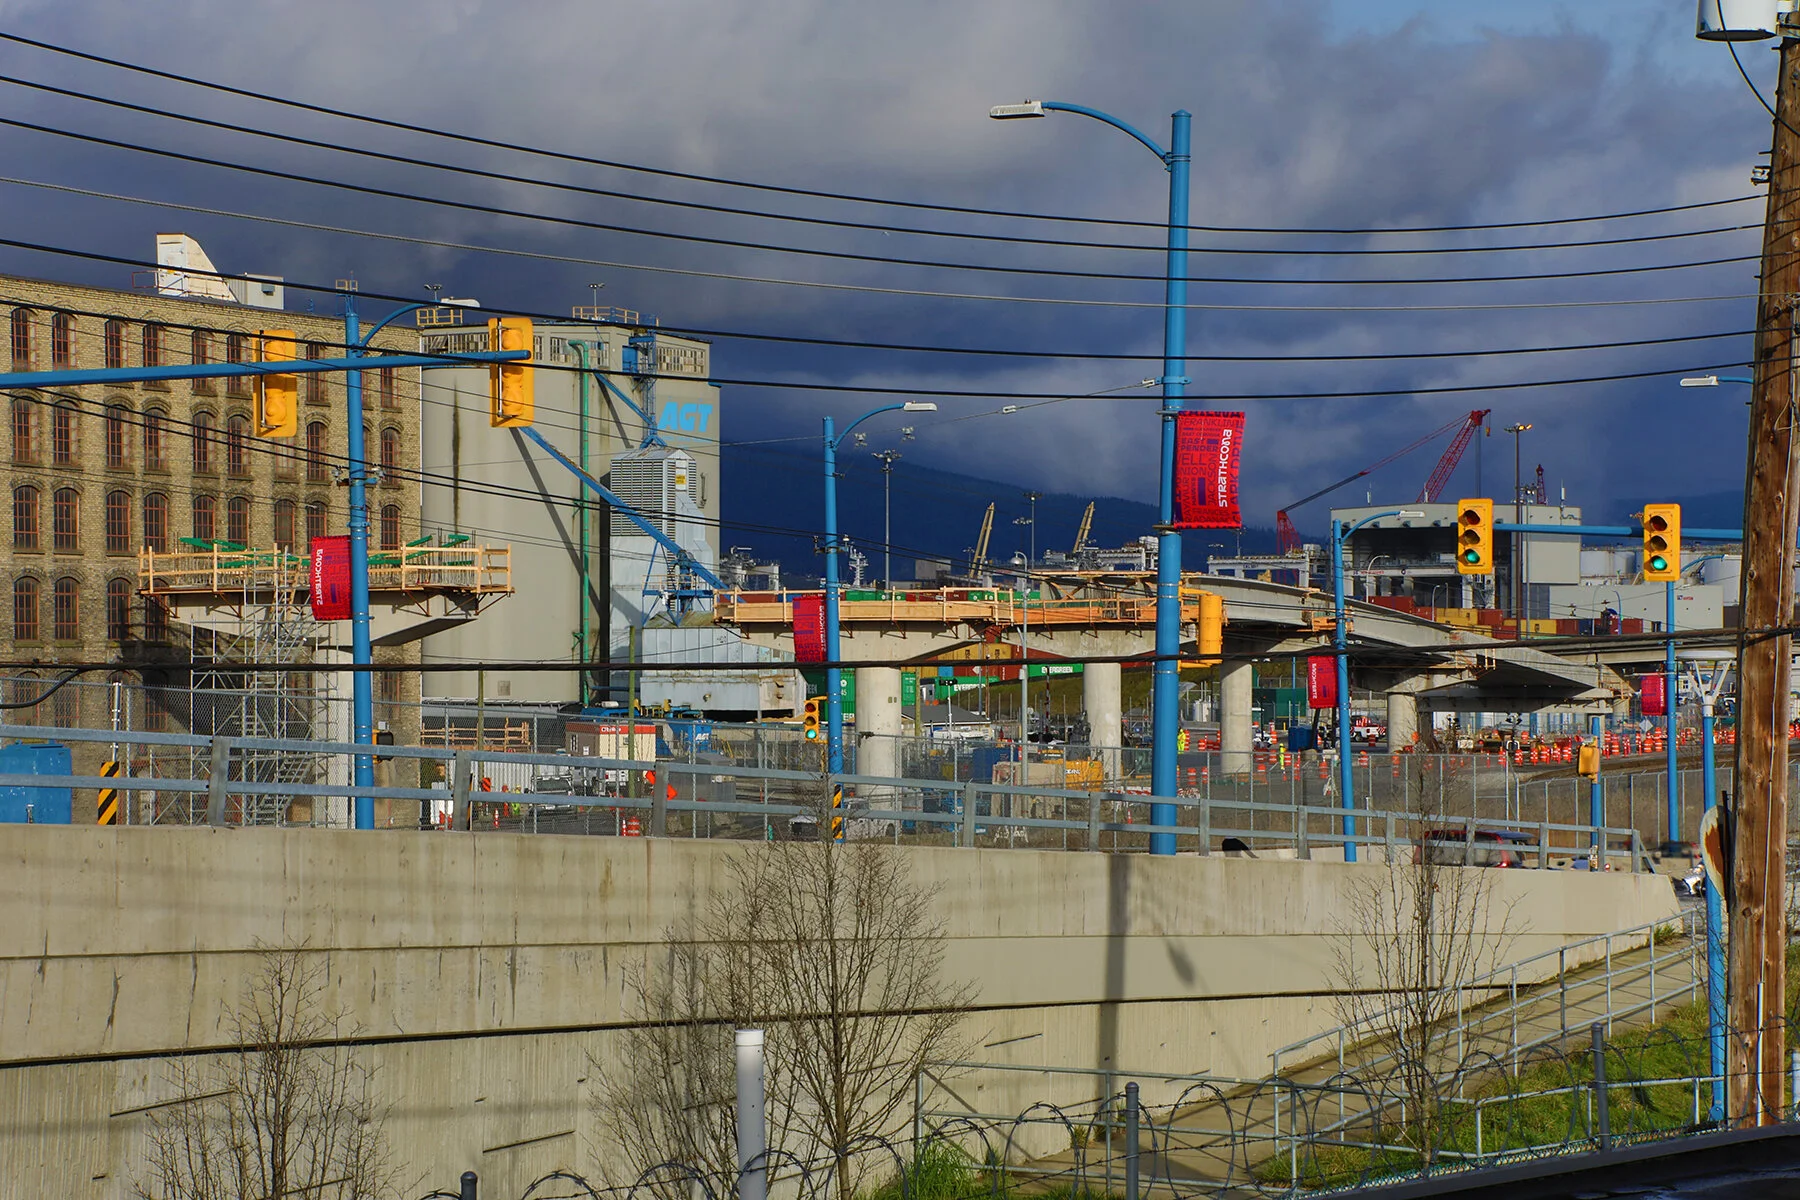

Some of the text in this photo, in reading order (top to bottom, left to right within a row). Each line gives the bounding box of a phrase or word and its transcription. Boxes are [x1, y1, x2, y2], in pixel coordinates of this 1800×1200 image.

[657, 401, 713, 433] AGT
[1183, 418, 1234, 428] FRANKLIN
[1208, 453, 1217, 506] JACKSON
[1183, 477, 1191, 523] RAYMUR
